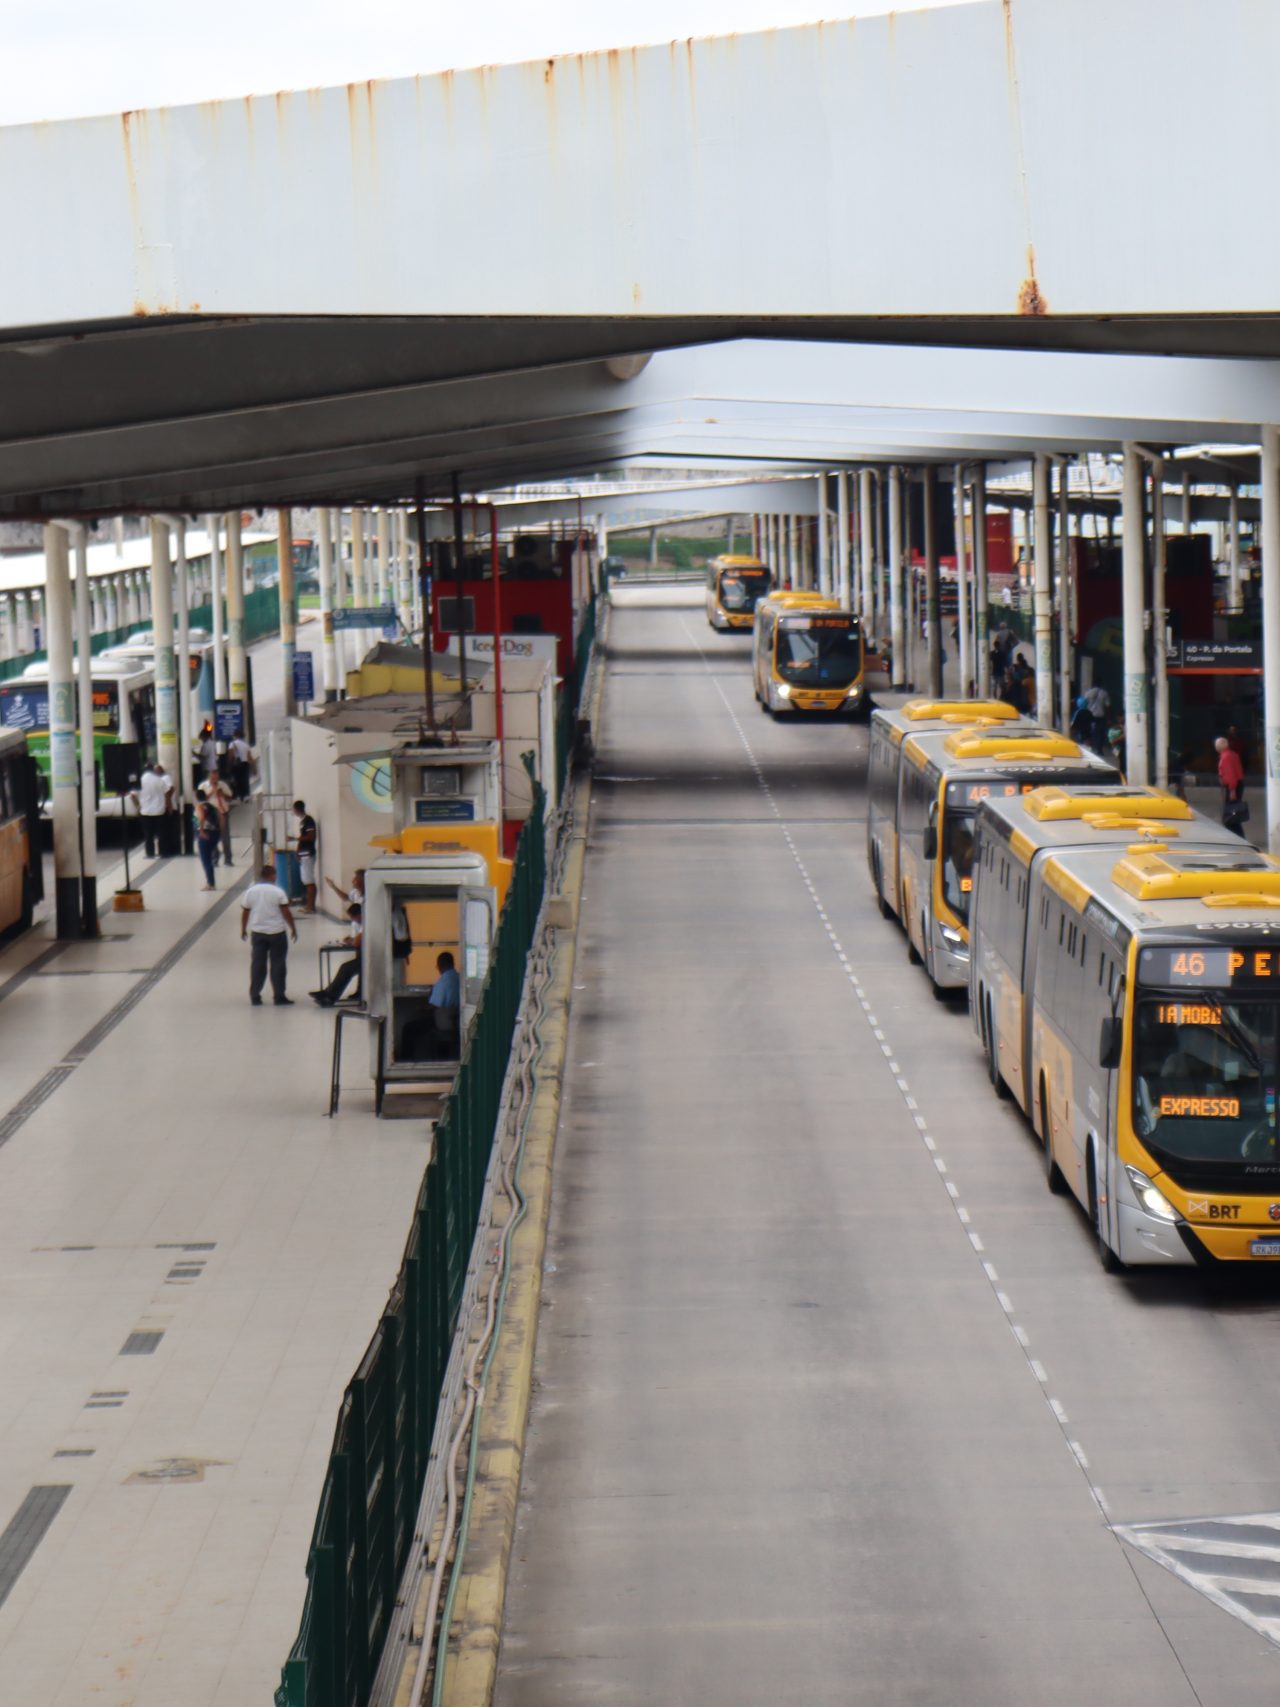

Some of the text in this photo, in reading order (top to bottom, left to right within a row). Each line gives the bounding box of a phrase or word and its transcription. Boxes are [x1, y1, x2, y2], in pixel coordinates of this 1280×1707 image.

[1173, 952, 1206, 976] 46
[1160, 1096, 1240, 1117] EXPRESSO
[1209, 1204, 1240, 1219] BRT
